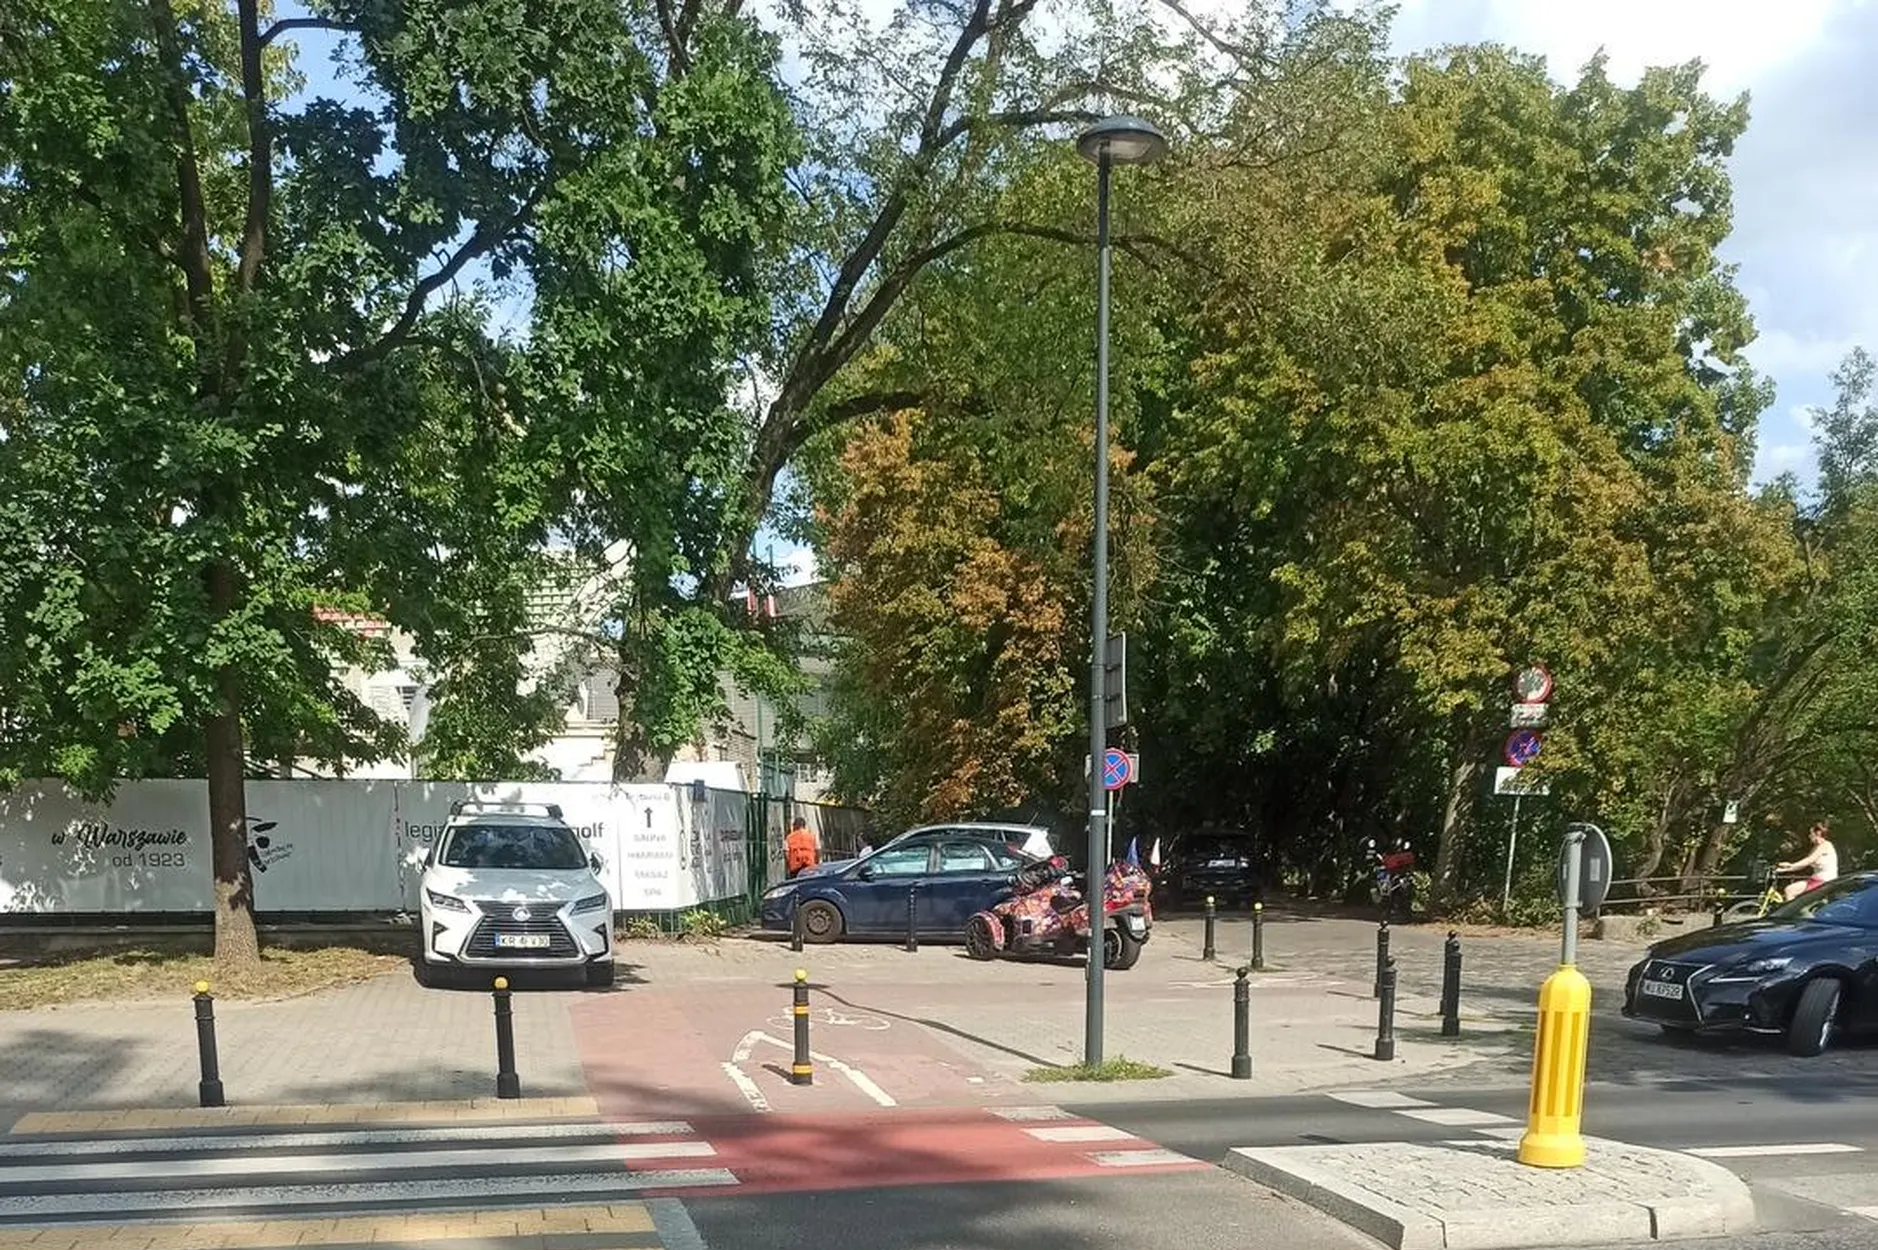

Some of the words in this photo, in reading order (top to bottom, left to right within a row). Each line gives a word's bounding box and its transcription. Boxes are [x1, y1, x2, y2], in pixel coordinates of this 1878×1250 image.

[51, 832, 65, 845] w
[77, 822, 187, 851] Warszawie
[112, 853, 133, 867] od
[138, 852, 185, 867] 1923
